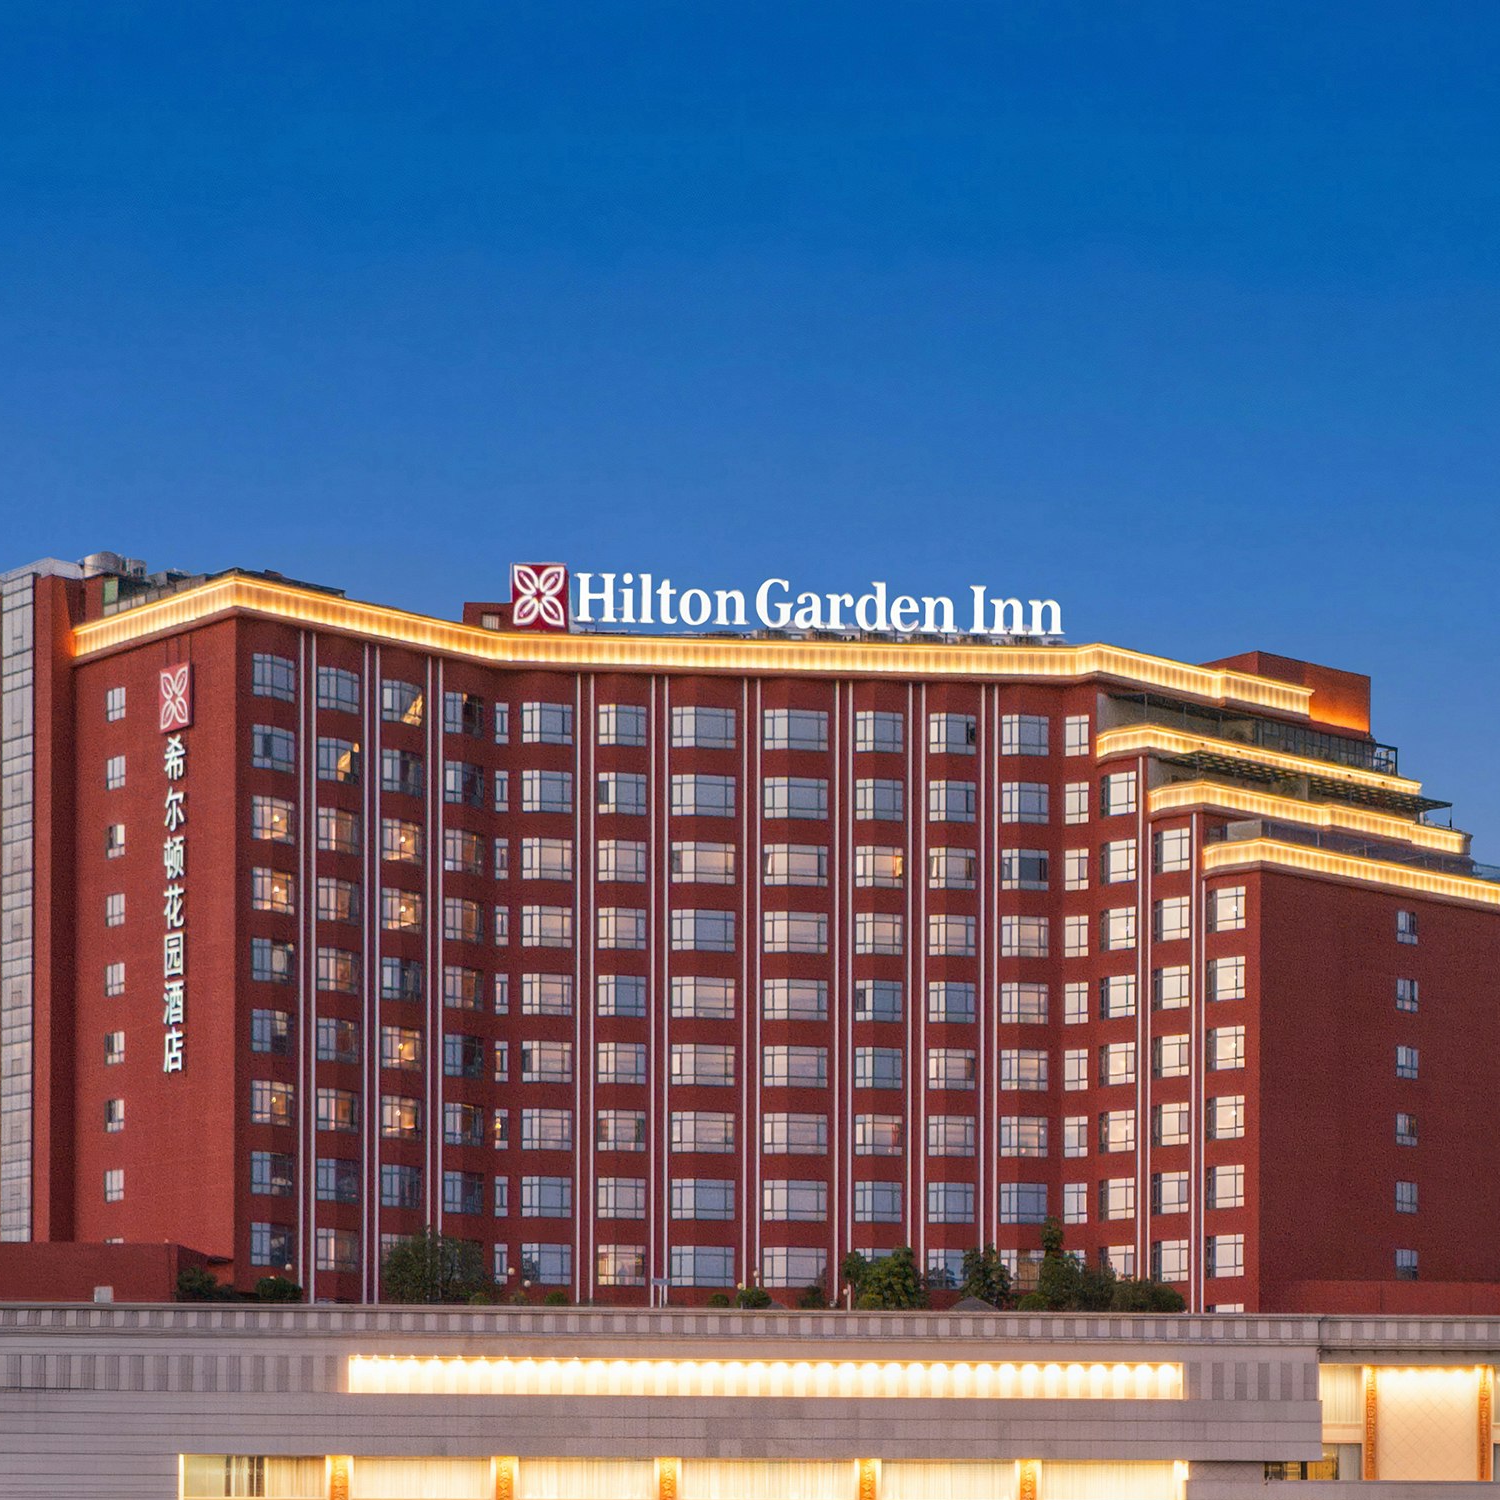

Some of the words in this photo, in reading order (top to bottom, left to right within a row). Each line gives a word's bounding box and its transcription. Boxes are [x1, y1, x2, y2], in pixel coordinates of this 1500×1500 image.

[575, 573, 748, 625] Hilton
[755, 578, 959, 634] Garden
[969, 584, 1066, 636] Inn
[163, 735, 185, 1073] 希尔顿花园酒店
